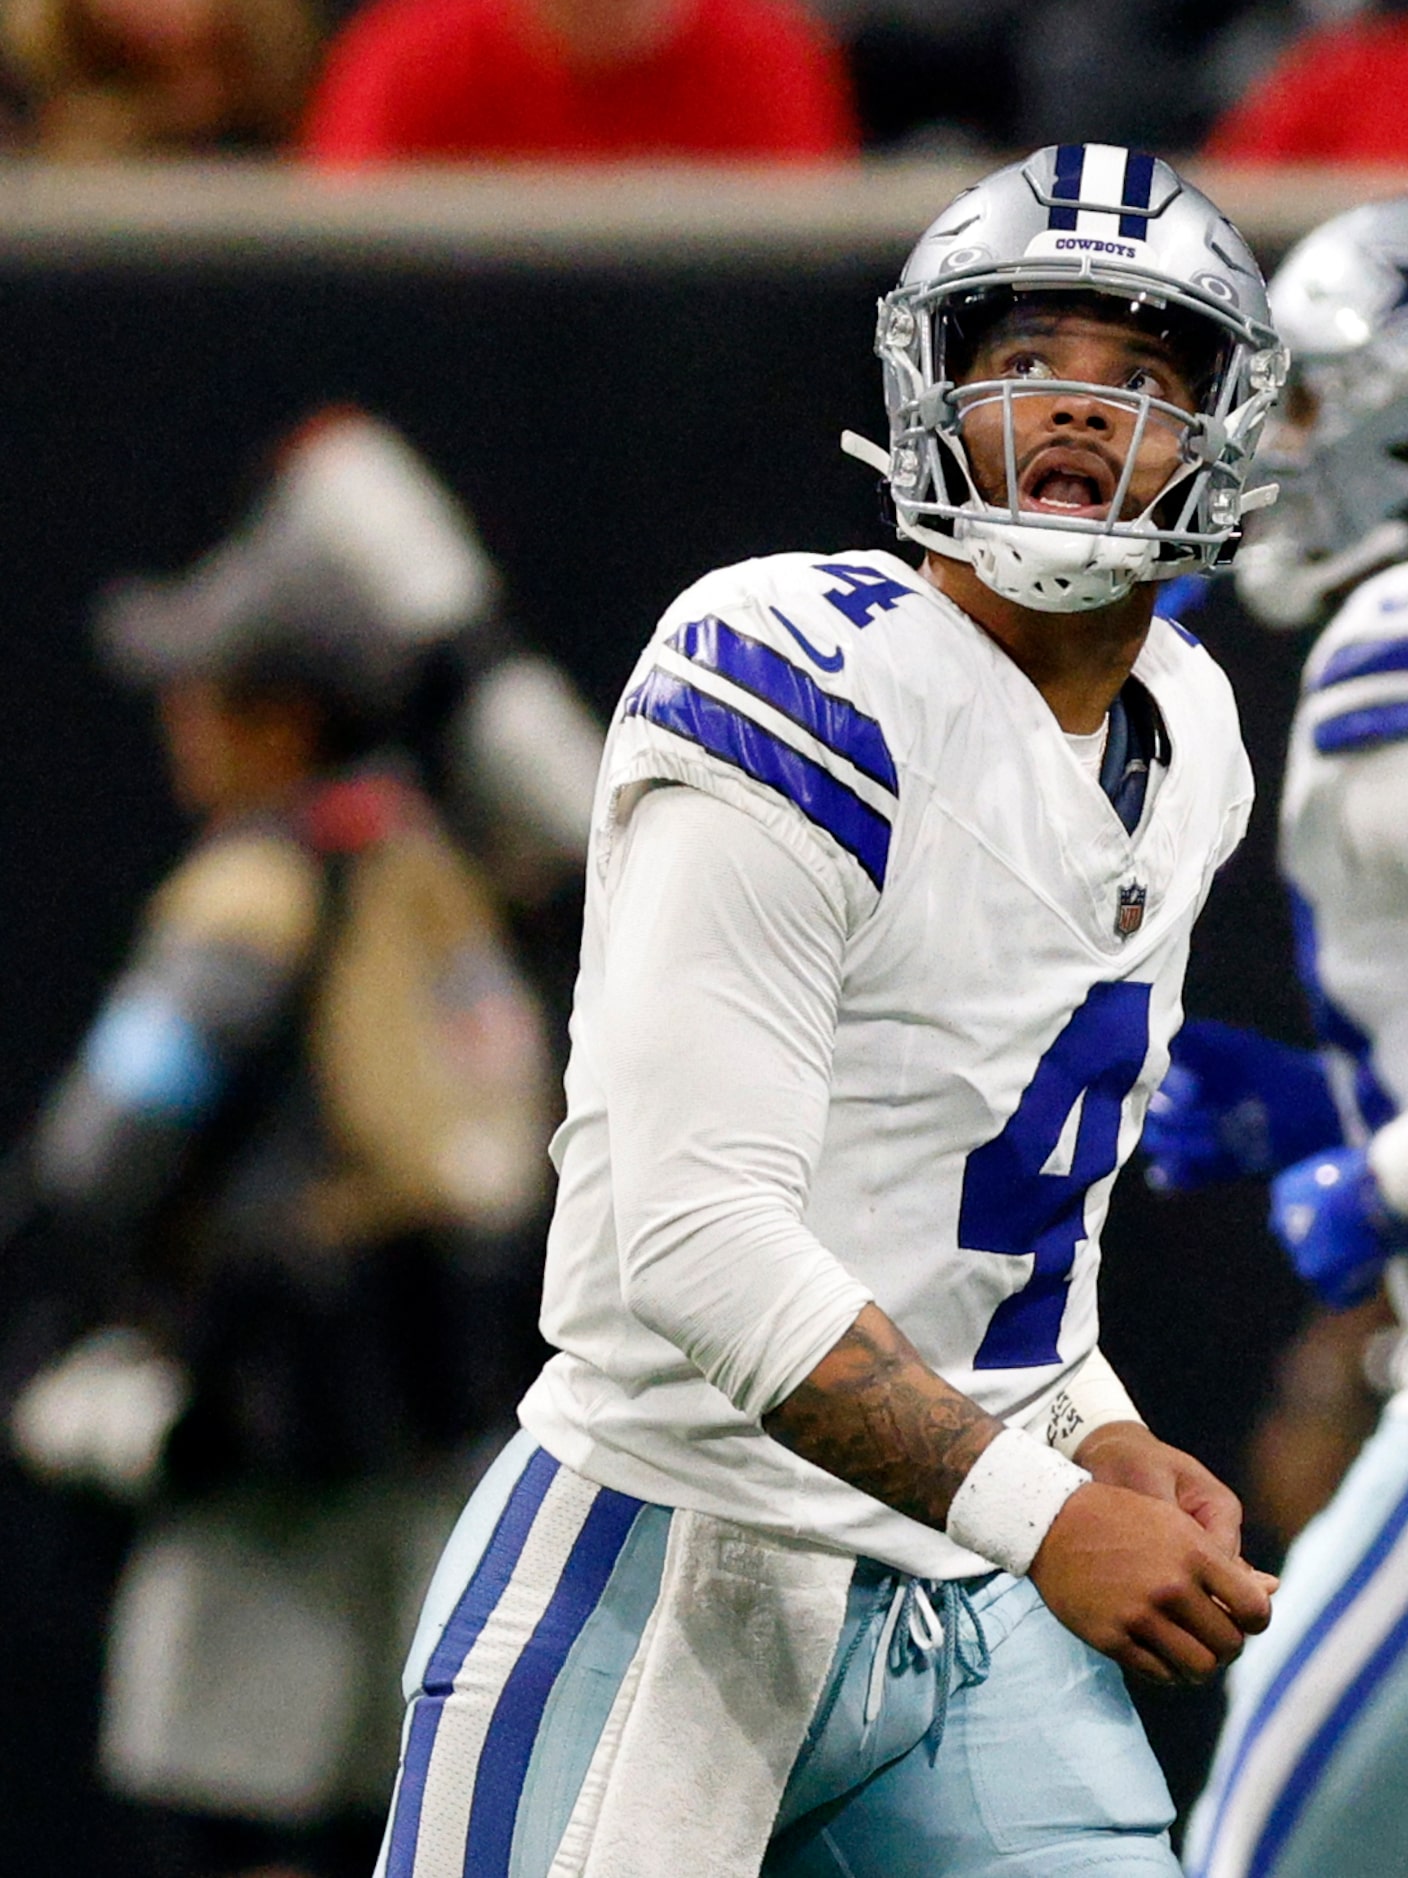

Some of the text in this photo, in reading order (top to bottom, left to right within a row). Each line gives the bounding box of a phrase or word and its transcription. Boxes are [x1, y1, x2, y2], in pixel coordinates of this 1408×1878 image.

[1055, 238, 1137, 259] COWBOYS
[811, 564, 919, 630] 4
[956, 981, 1154, 1371] 4
